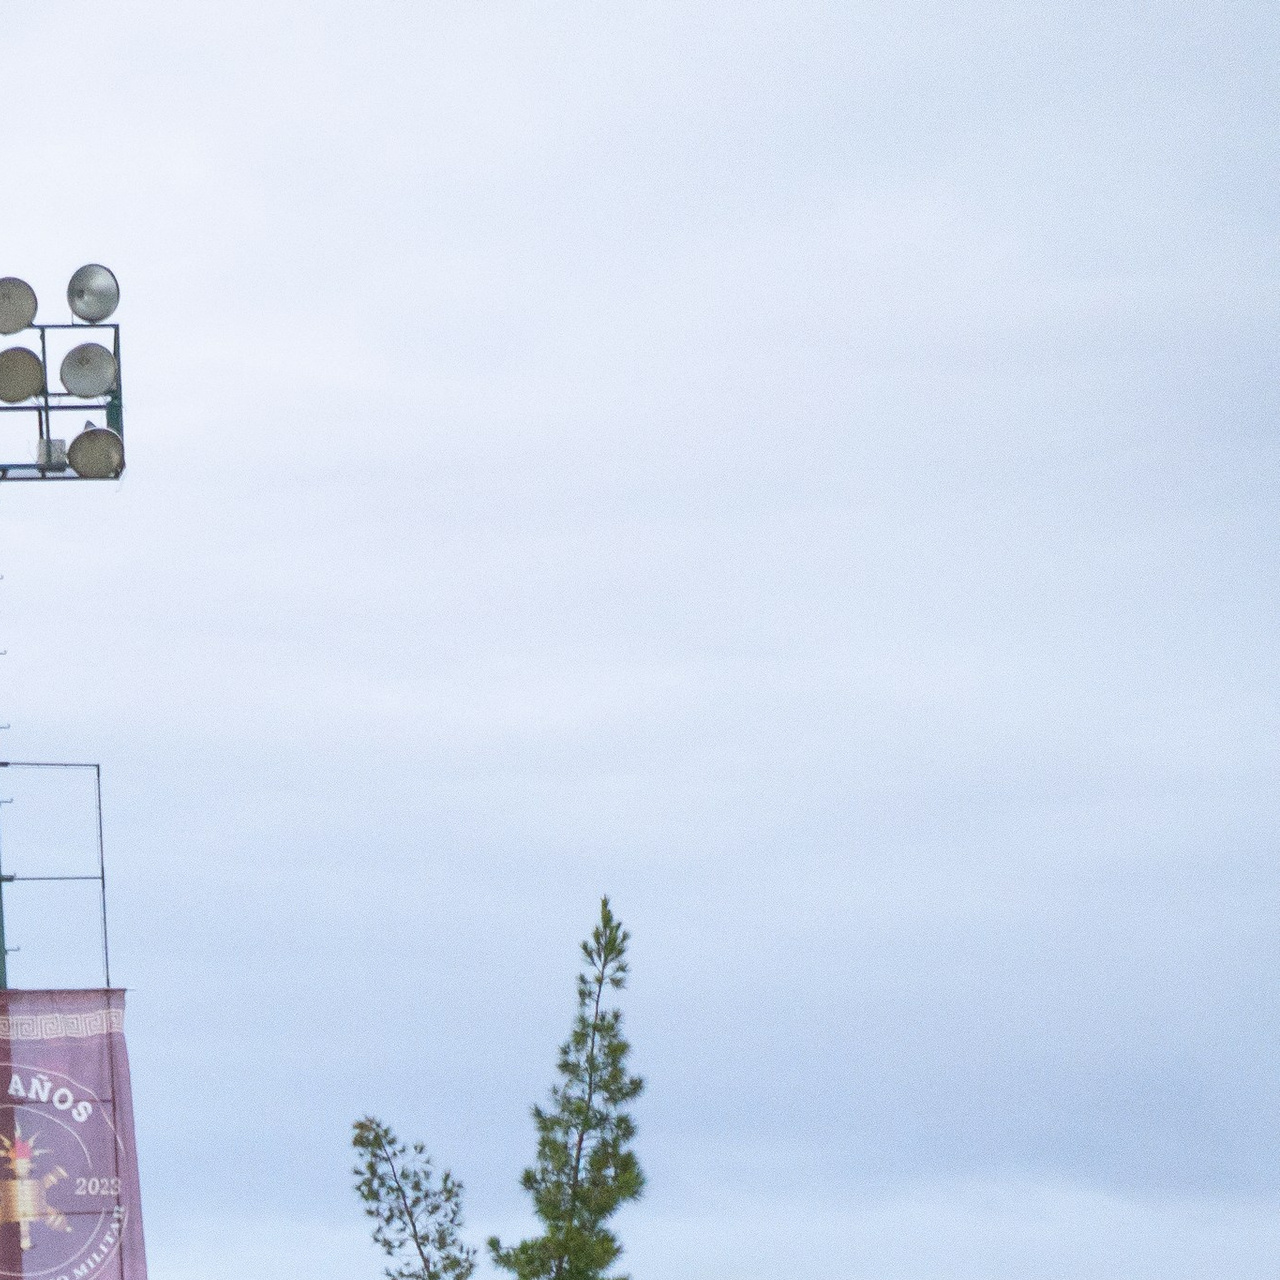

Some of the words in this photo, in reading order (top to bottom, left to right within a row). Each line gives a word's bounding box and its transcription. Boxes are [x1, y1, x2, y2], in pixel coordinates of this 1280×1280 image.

[8, 1073, 93, 1123] AÑOS
[75, 1177, 121, 1196] 2023
[73, 1204, 125, 1279] MILITAR
